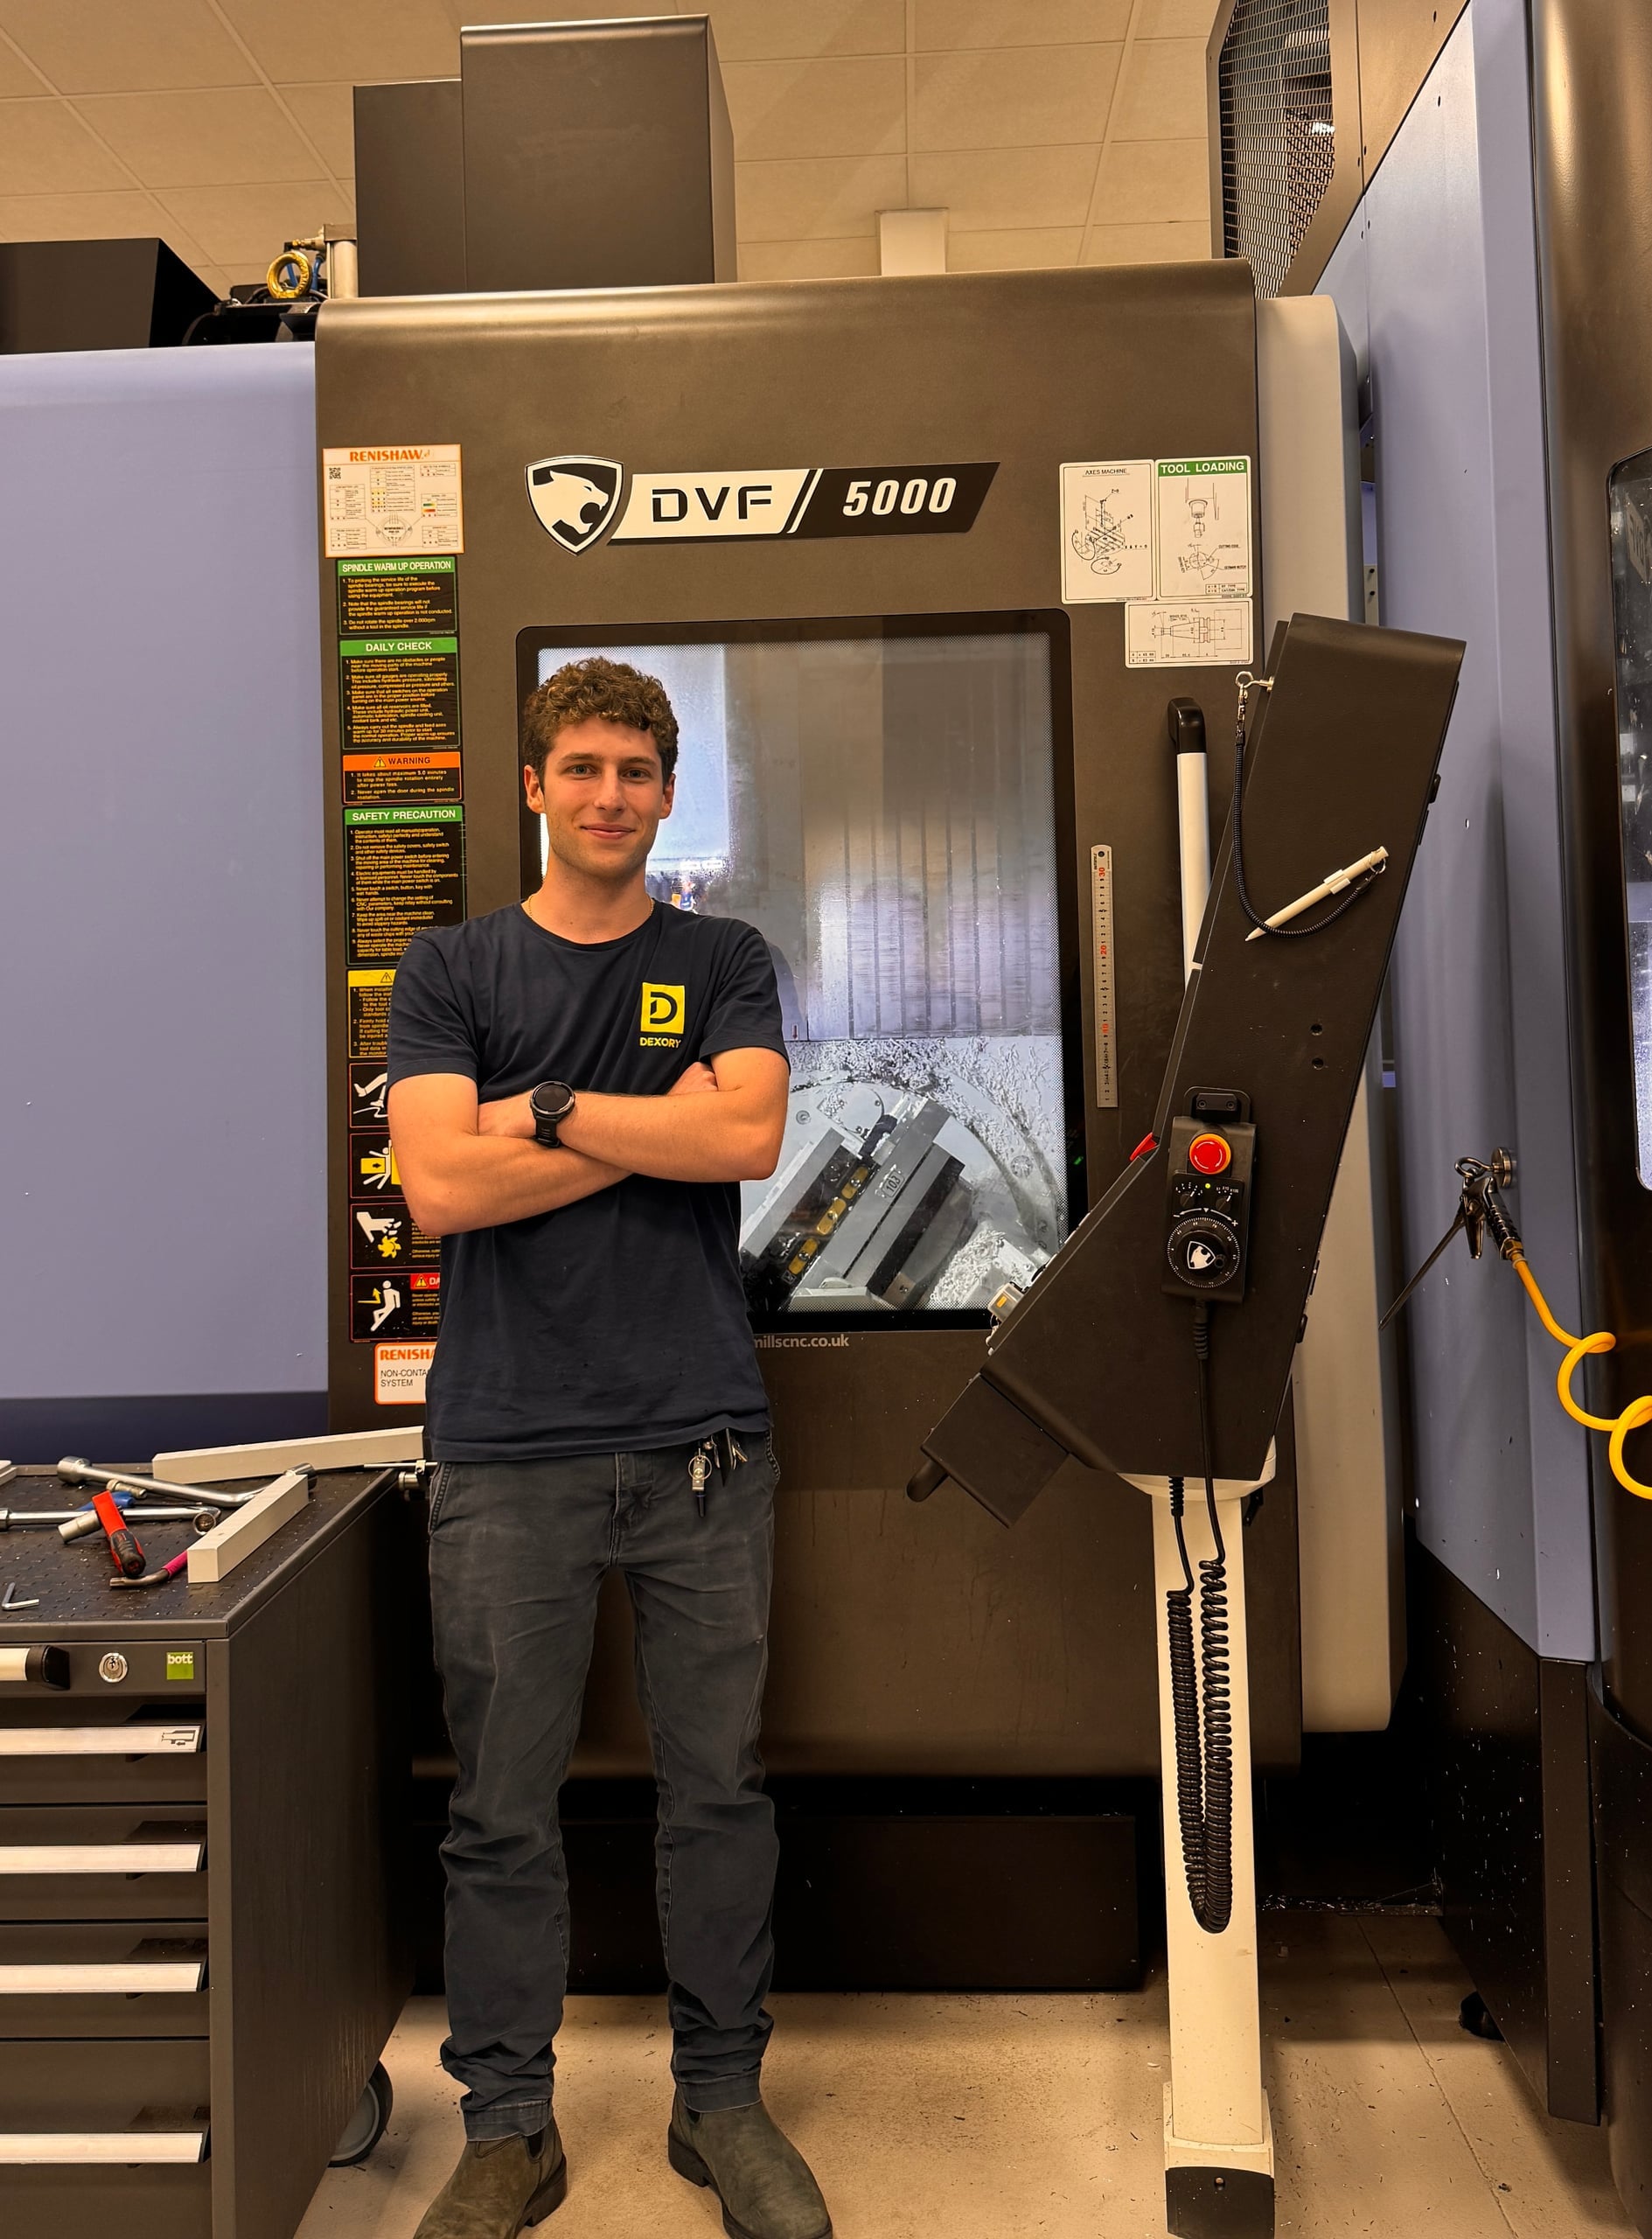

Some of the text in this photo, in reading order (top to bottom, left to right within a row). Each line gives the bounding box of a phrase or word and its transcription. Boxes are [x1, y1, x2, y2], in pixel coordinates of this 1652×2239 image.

[350, 450, 423, 462] RENISHAW
[1161, 461, 1244, 474] TOOL LOADING
[652, 477, 956, 522] DVF 5000
[343, 561, 451, 572] SPINDLE WARM UP OPERATION
[366, 642, 432, 652] DAILY CHECK
[352, 810, 455, 821] SAFETY PRECAUTION
[1099, 868, 1105, 877] 30
[1101, 945, 1107, 955] 20
[650, 992, 678, 1024] D
[640, 1037, 681, 1048] DEXORY
[381, 1379, 413, 1387] SYSTEM
[167, 1654, 193, 1664] bott
